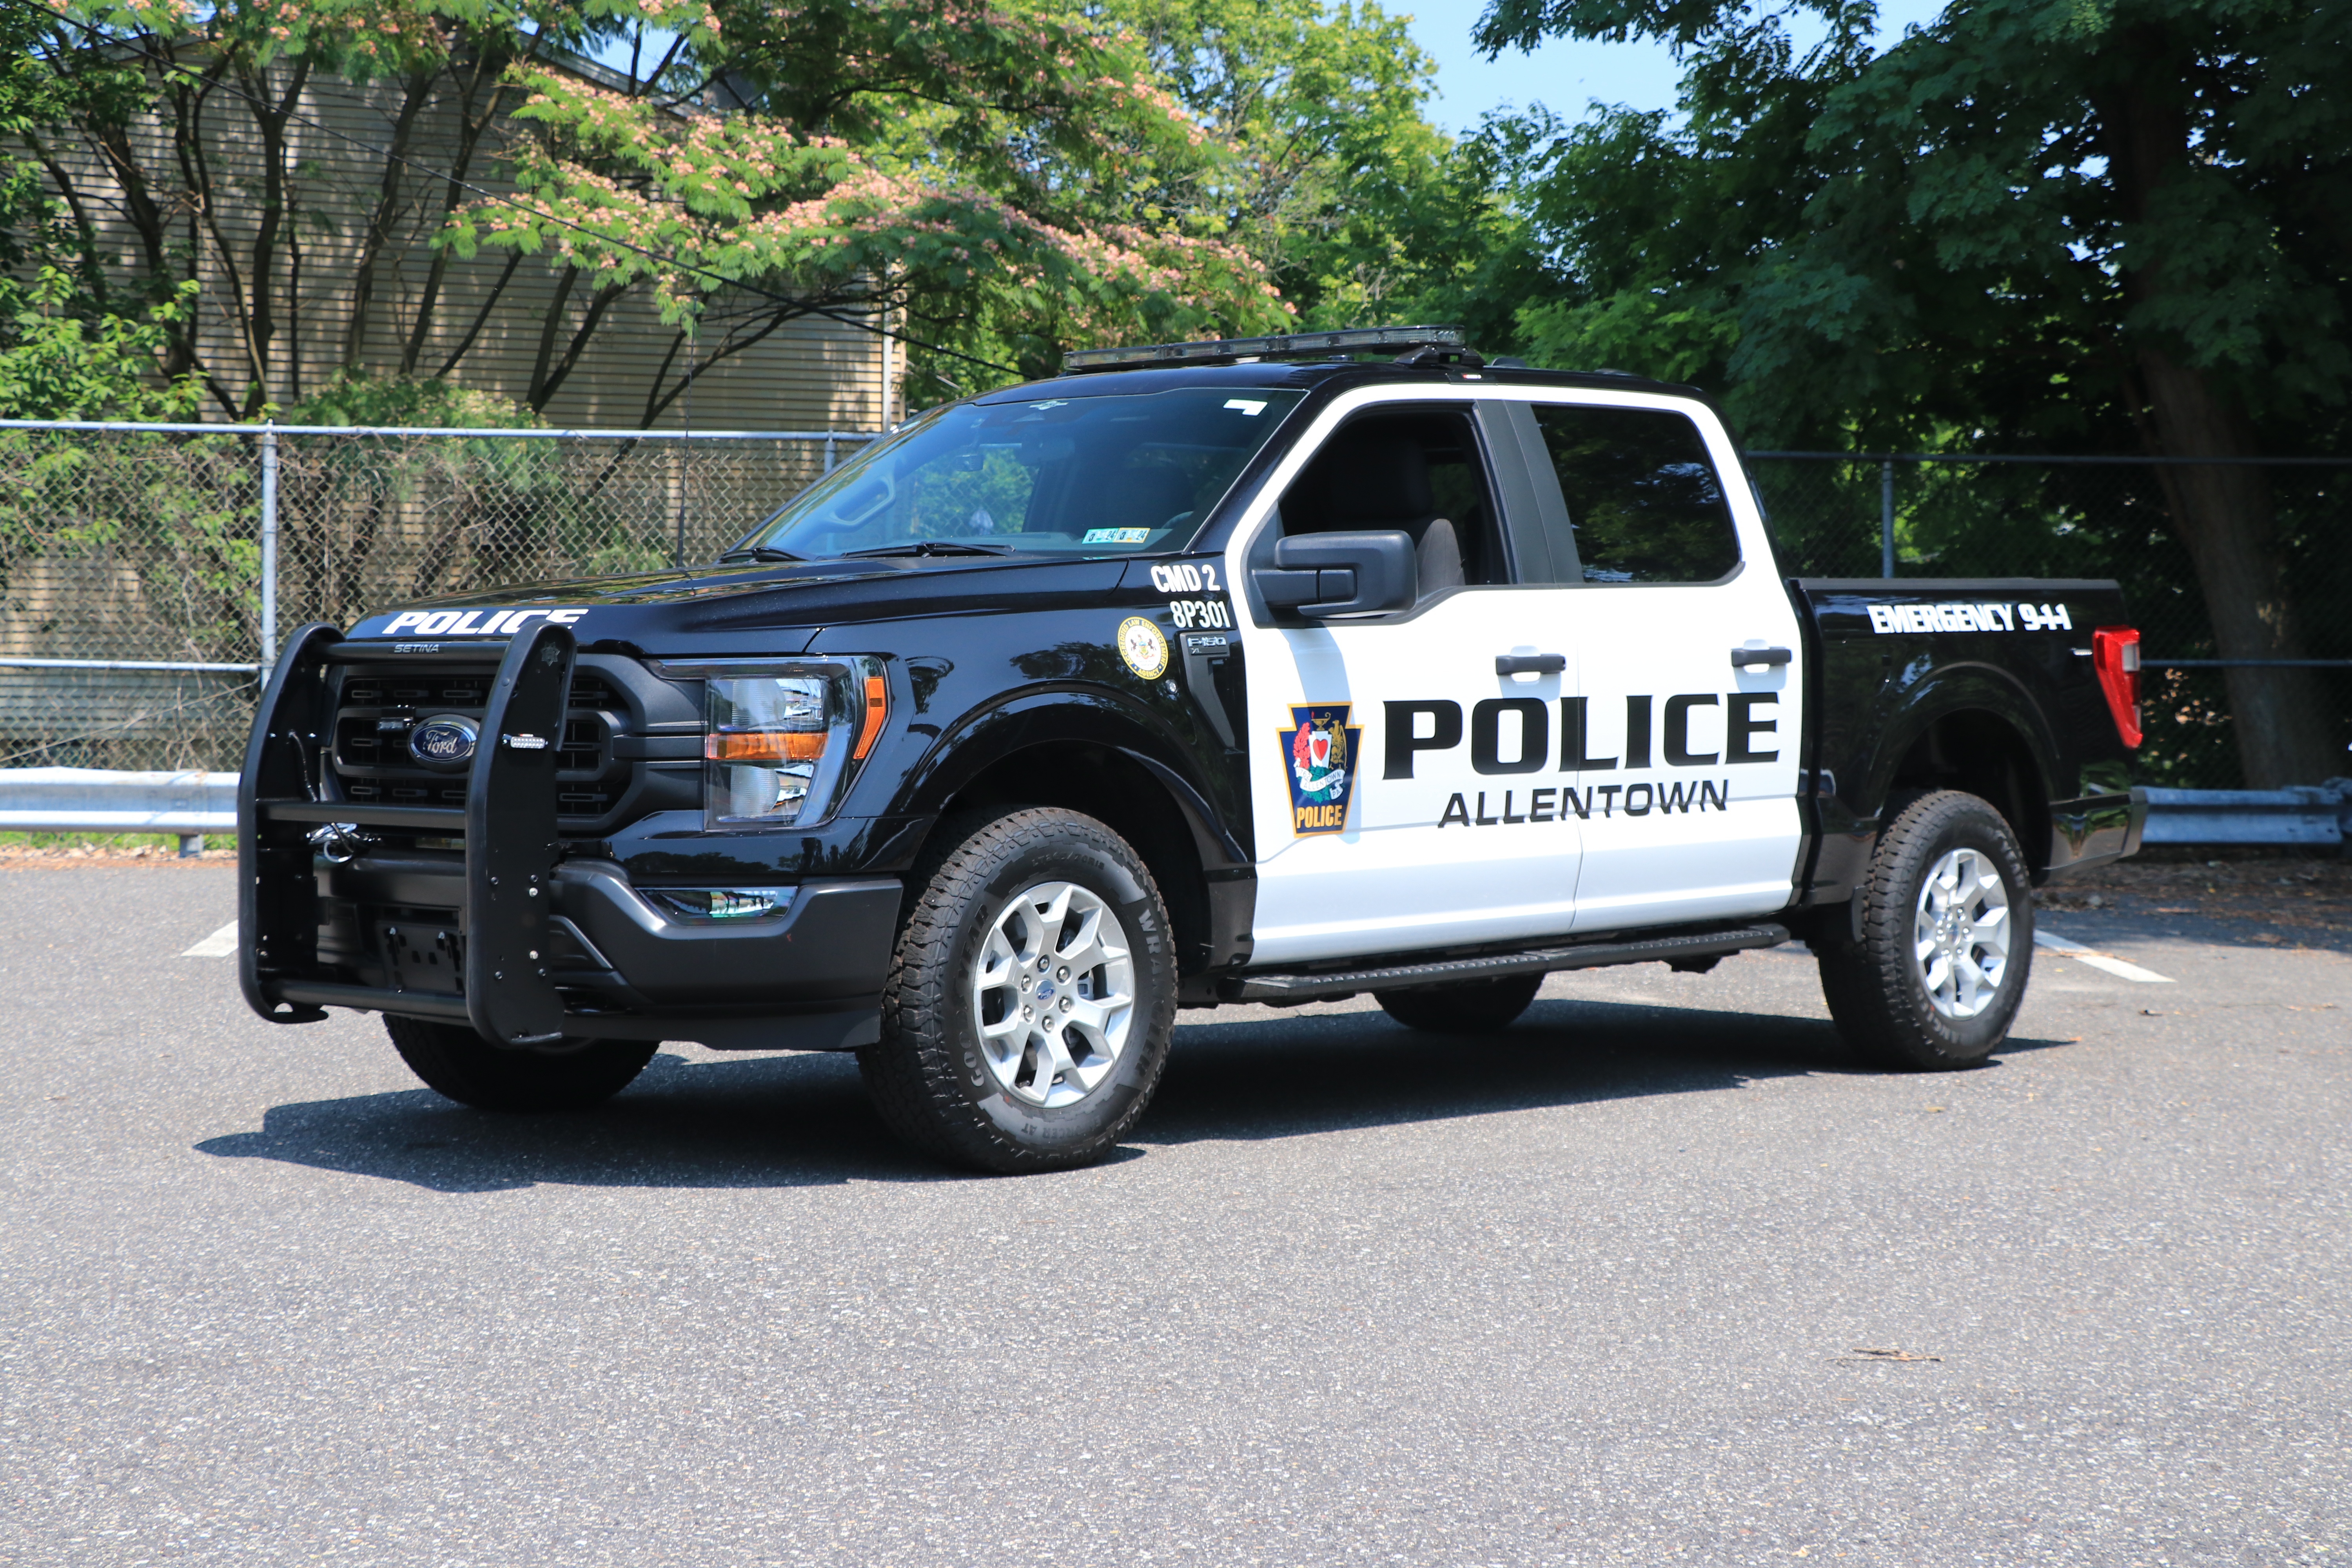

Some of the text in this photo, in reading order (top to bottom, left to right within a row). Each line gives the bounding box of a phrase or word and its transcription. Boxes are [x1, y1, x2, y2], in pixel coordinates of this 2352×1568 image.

[1089, 530, 1116, 542] 3 24
[1120, 530, 1147, 540] 3 24
[1151, 564, 1221, 593] CMD 2
[1170, 600, 1231, 628] 8P301
[1866, 604, 2015, 633] EMERGENCY
[394, 644, 439, 653] SETINA
[1120, 624, 1134, 665] ACCREDITED
[1141, 620, 1166, 667] ENFORCEMENT
[1187, 637, 1227, 647] F-150
[1138, 668, 1159, 677] AGENCY
[423, 730, 459, 754] Ford
[1383, 692, 1780, 780] POLICE
[1298, 768, 1311, 780] 1762
[1303, 771, 1341, 790] ALLENTOWN
[1437, 780, 1728, 828] ALLENTOWN
[1296, 805, 1343, 829] POLICE
